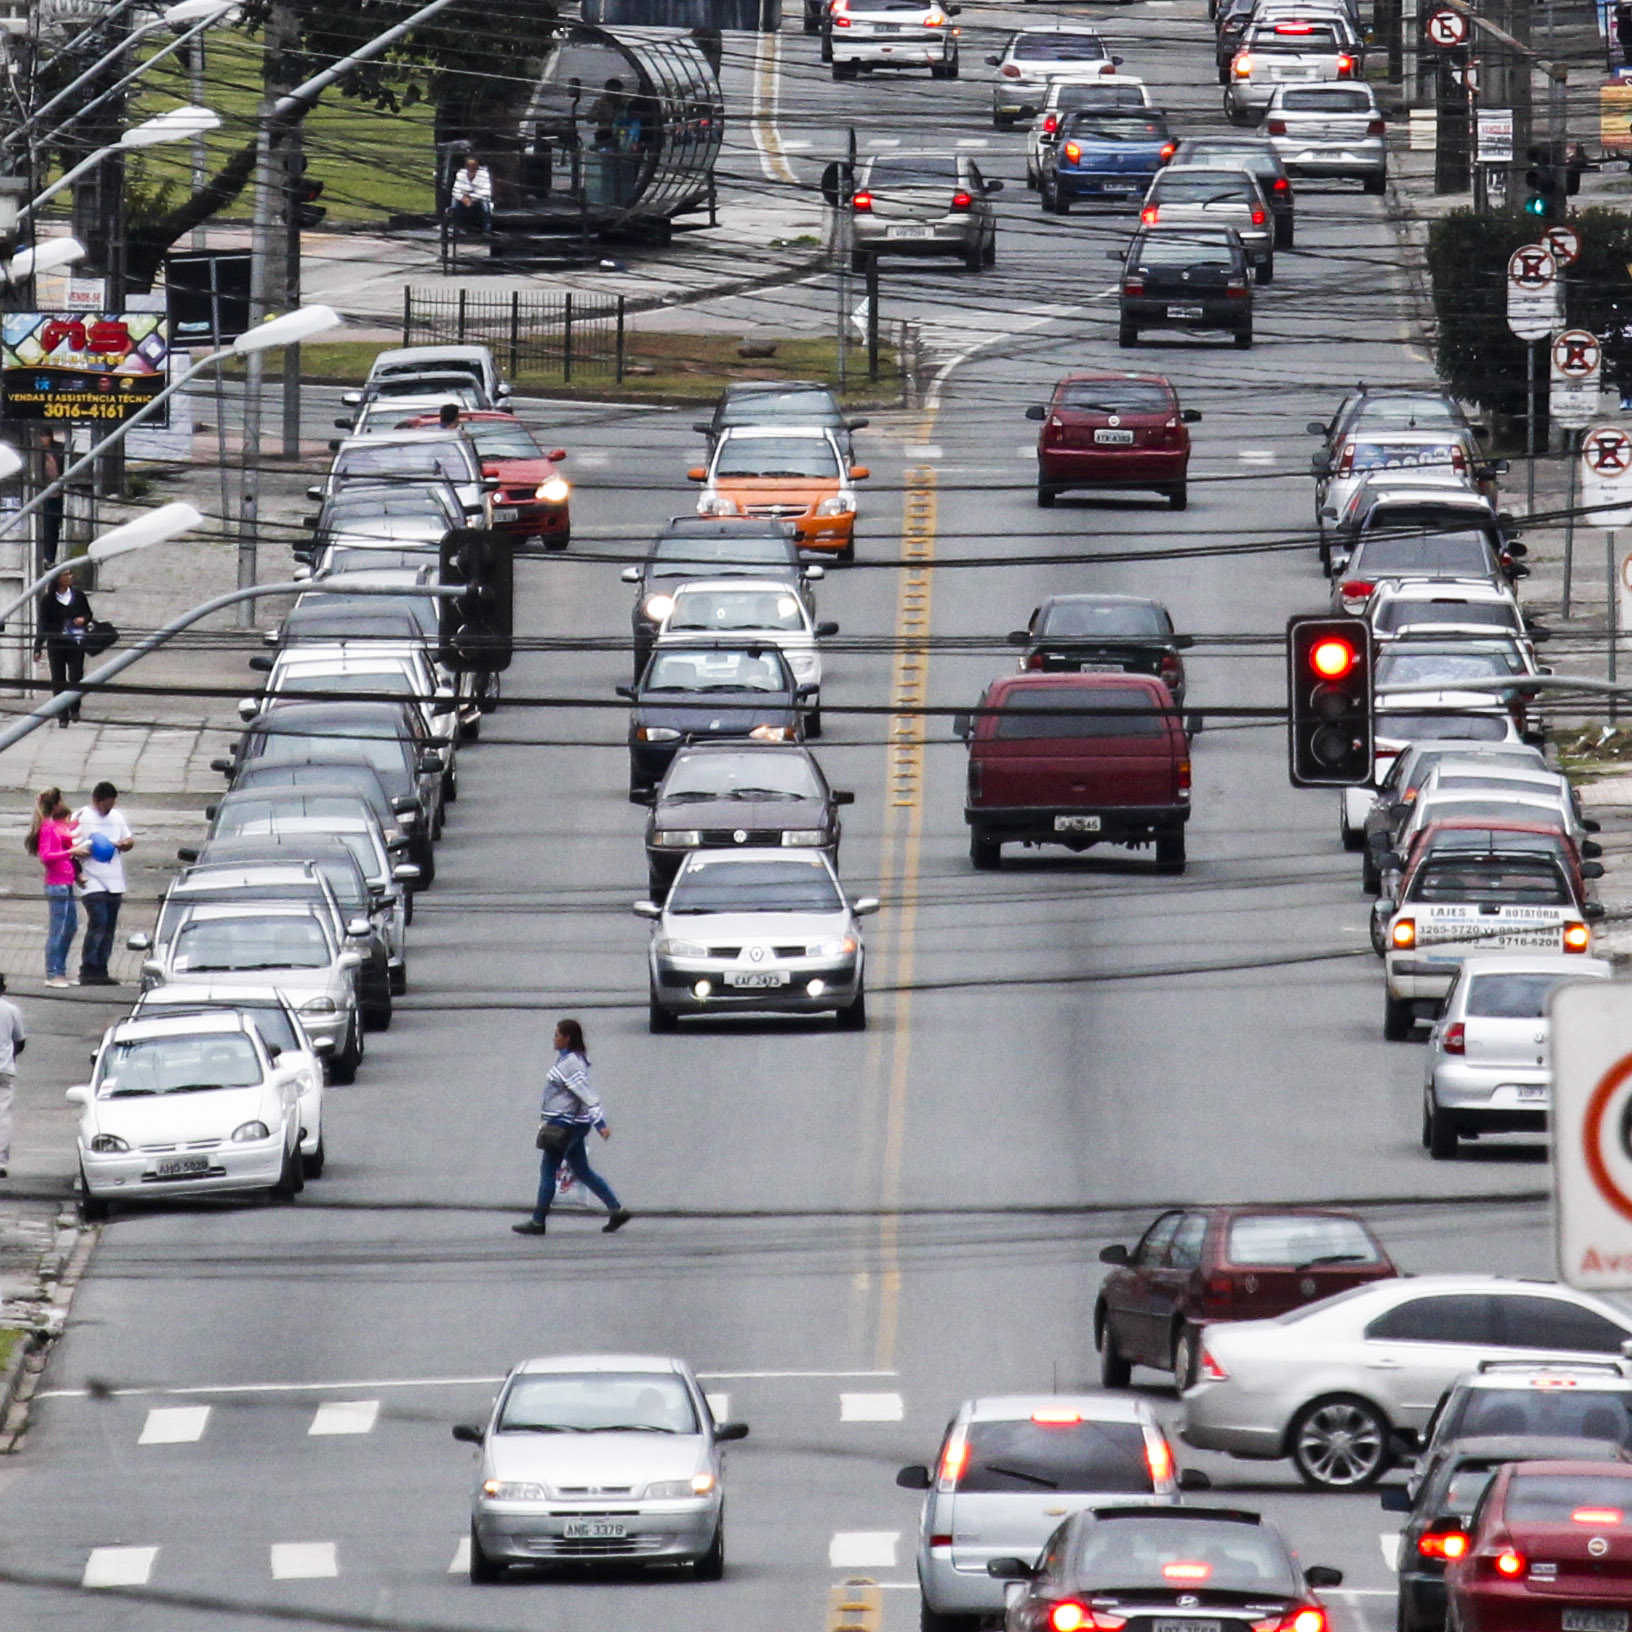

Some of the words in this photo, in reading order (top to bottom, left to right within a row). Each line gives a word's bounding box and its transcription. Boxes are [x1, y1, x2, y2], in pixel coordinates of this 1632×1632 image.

[7, 393, 45, 402] VENDAS
[54, 391, 117, 403] ASSISTÊNCIA
[117, 391, 158, 404] TÉCNIC
[43, 403, 125, 419] 3016-4161
[1429, 907, 1467, 918] LAJES
